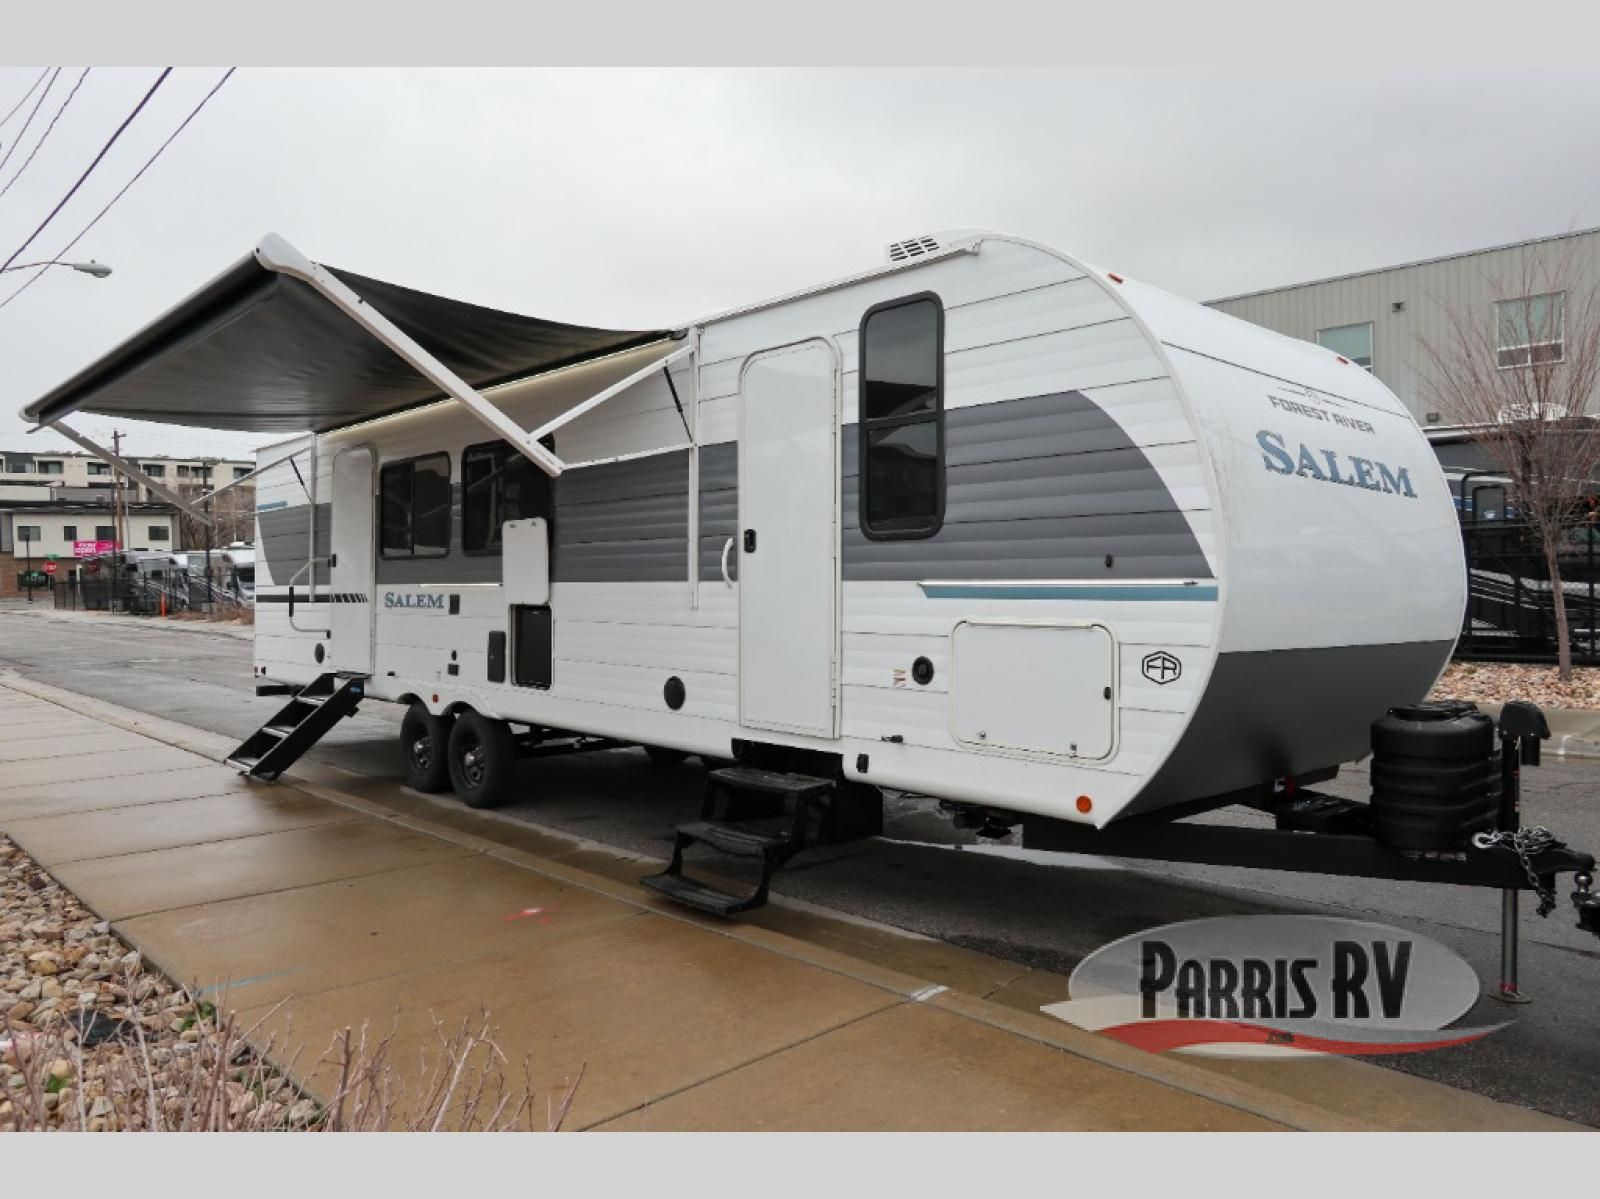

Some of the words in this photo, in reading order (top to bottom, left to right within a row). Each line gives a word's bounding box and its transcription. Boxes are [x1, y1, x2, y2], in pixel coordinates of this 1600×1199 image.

[1267, 394, 1331, 422] FOREST
[1331, 413, 1376, 434] RIVER
[1256, 429, 1418, 498] SALEM
[384, 591, 445, 609] SALEM
